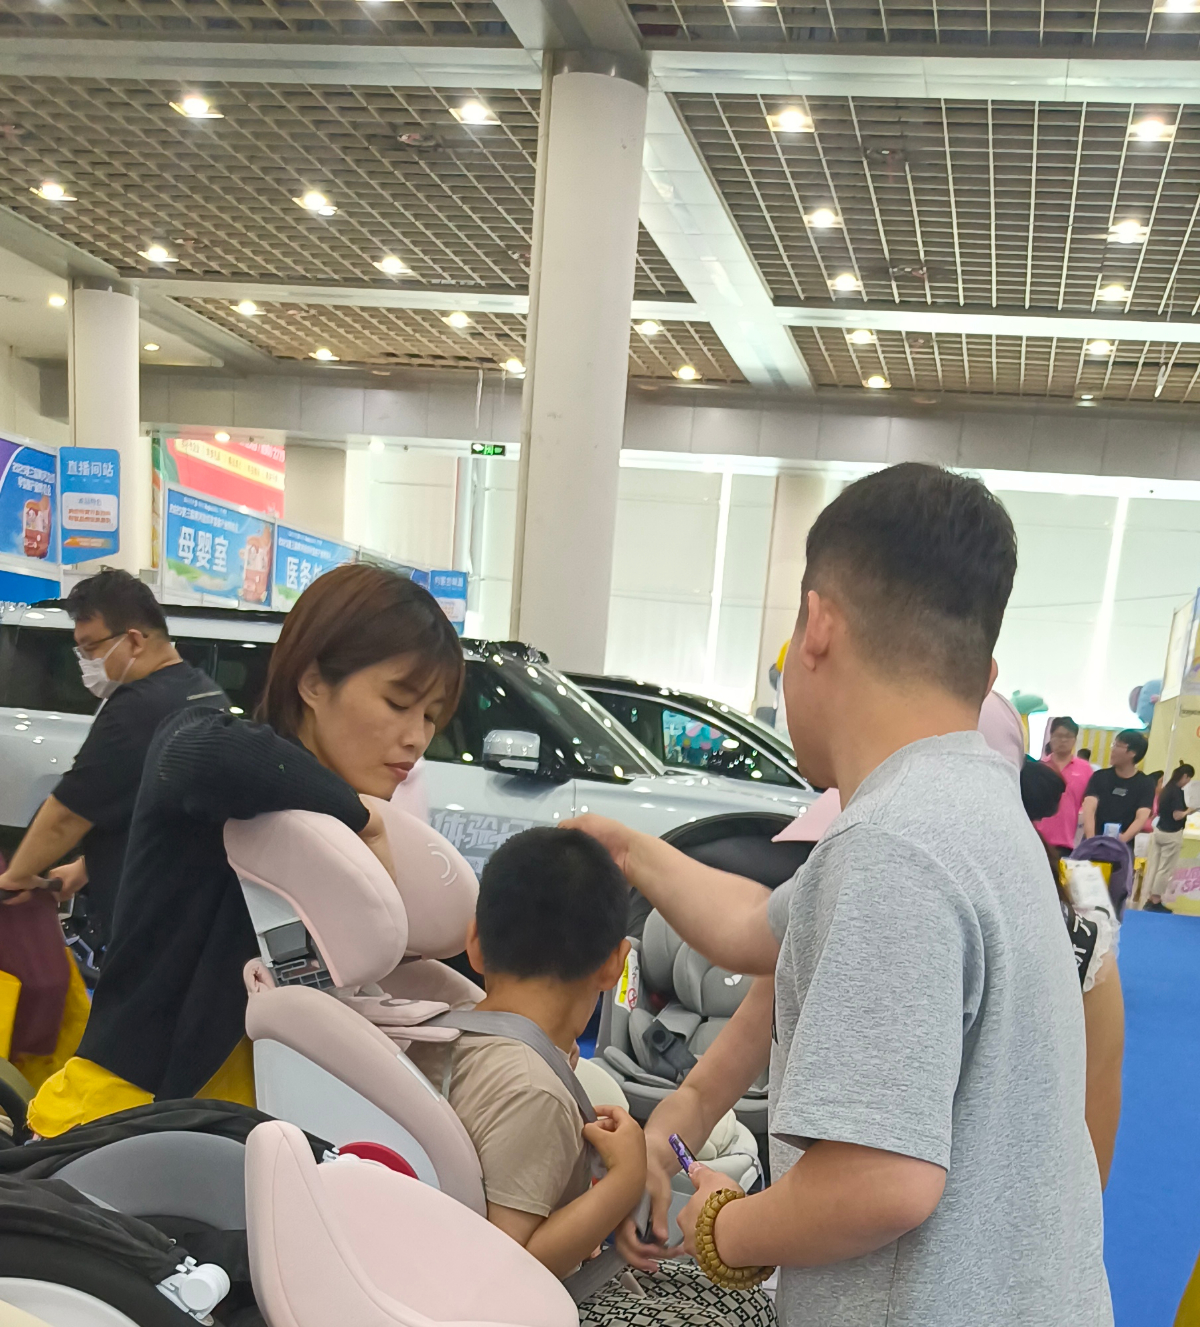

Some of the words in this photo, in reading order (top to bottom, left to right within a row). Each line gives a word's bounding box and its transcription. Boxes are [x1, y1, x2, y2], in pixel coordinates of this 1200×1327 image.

[178, 525, 229, 574] 母婴室
[428, 810, 534, 850] 体验
